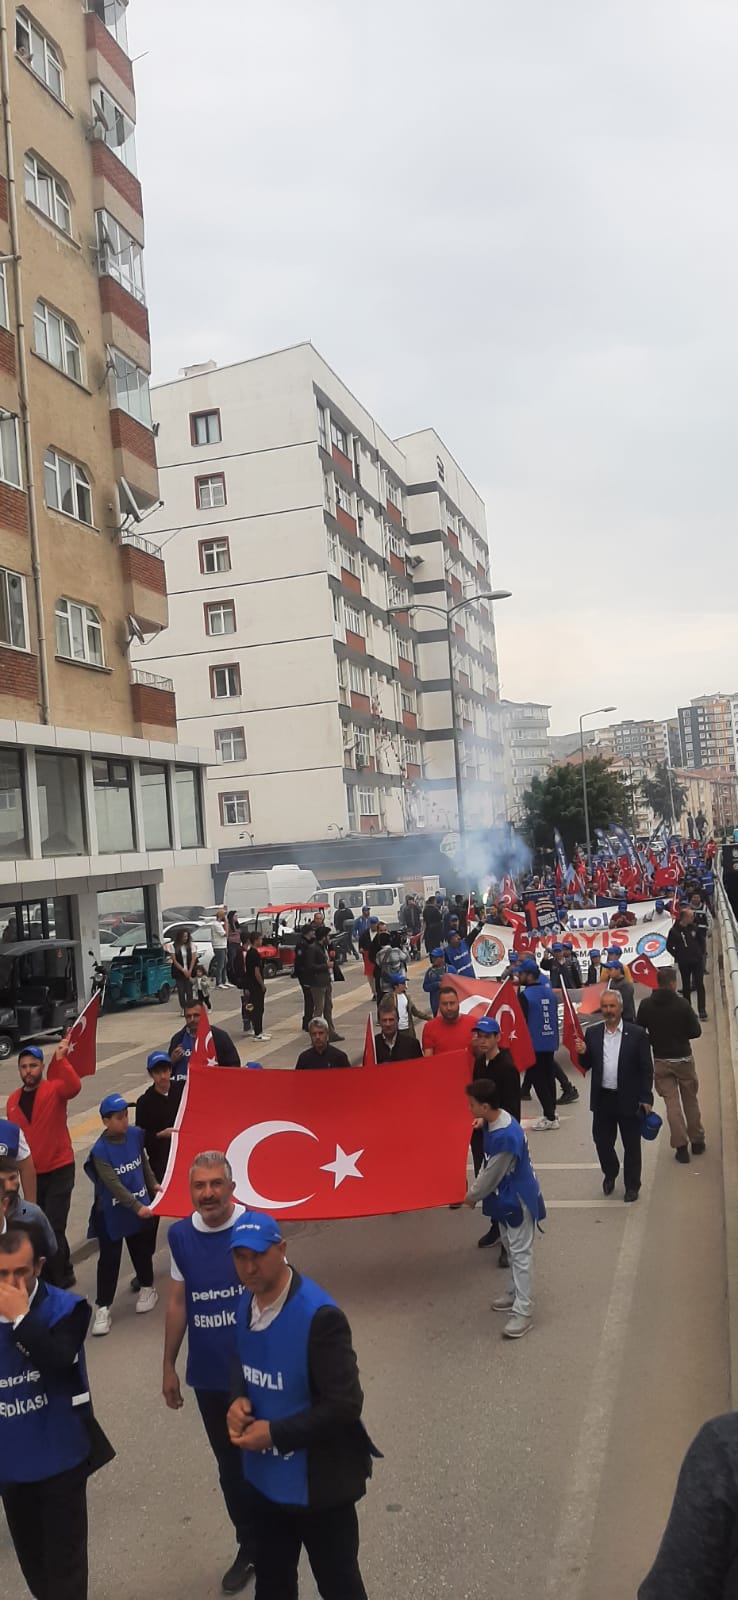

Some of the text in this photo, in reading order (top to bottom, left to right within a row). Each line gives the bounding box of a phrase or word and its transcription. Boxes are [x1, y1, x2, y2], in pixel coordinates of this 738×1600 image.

[192, 1285, 245, 1302] petrol-i
[194, 1311, 237, 1328] SENDİK
[242, 1364, 283, 1390] REVLİ
